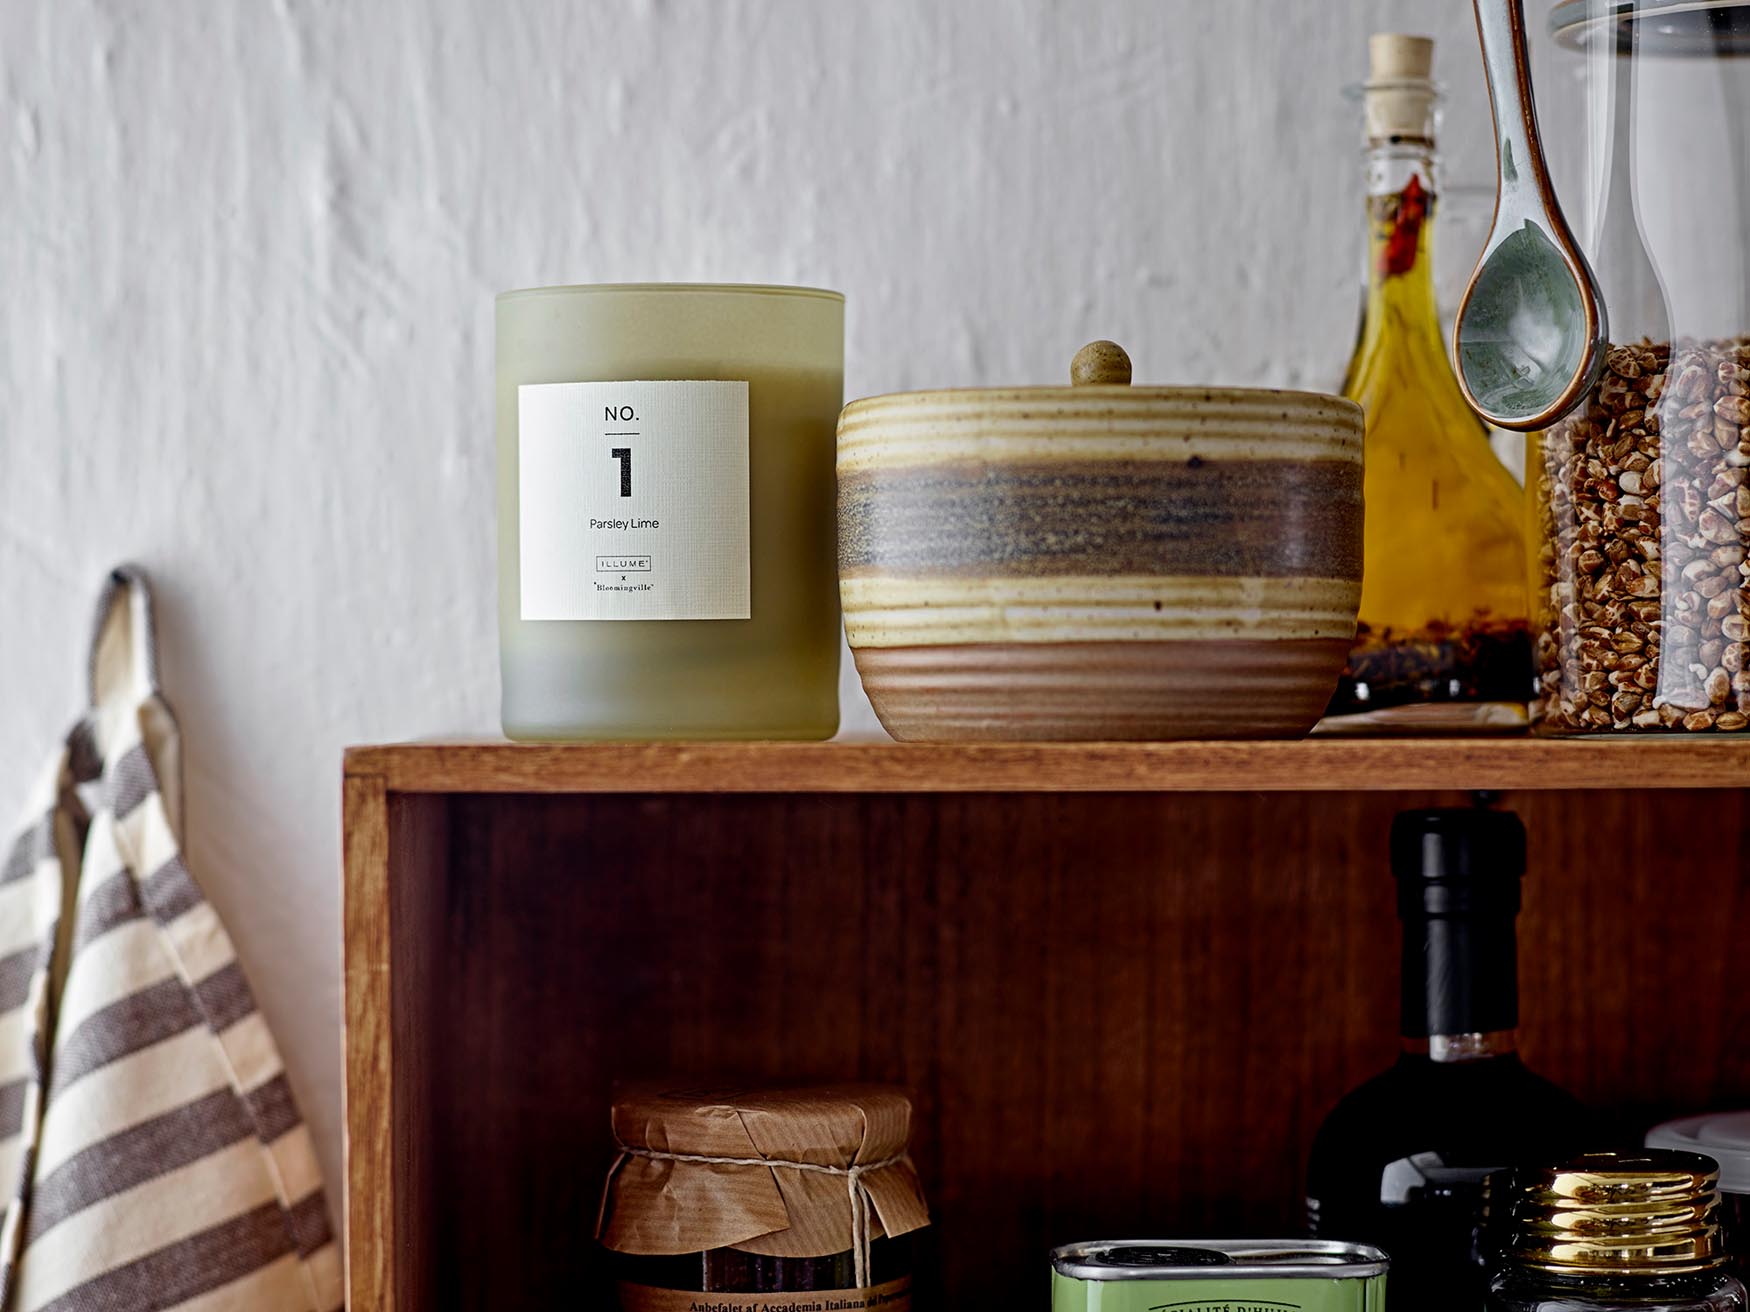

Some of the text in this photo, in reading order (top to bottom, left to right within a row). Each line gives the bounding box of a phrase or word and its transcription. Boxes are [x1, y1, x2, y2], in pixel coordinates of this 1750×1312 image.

[605, 406, 640, 421] NO.
[611, 448, 631, 497] 1
[590, 518, 659, 531] Parsley Lime
[689, 1301, 743, 1312] Anbefalet
[746, 1303, 758, 1312] af
[761, 1301, 822, 1312] Accademia
[825, 1299, 864, 1310] Italiana
